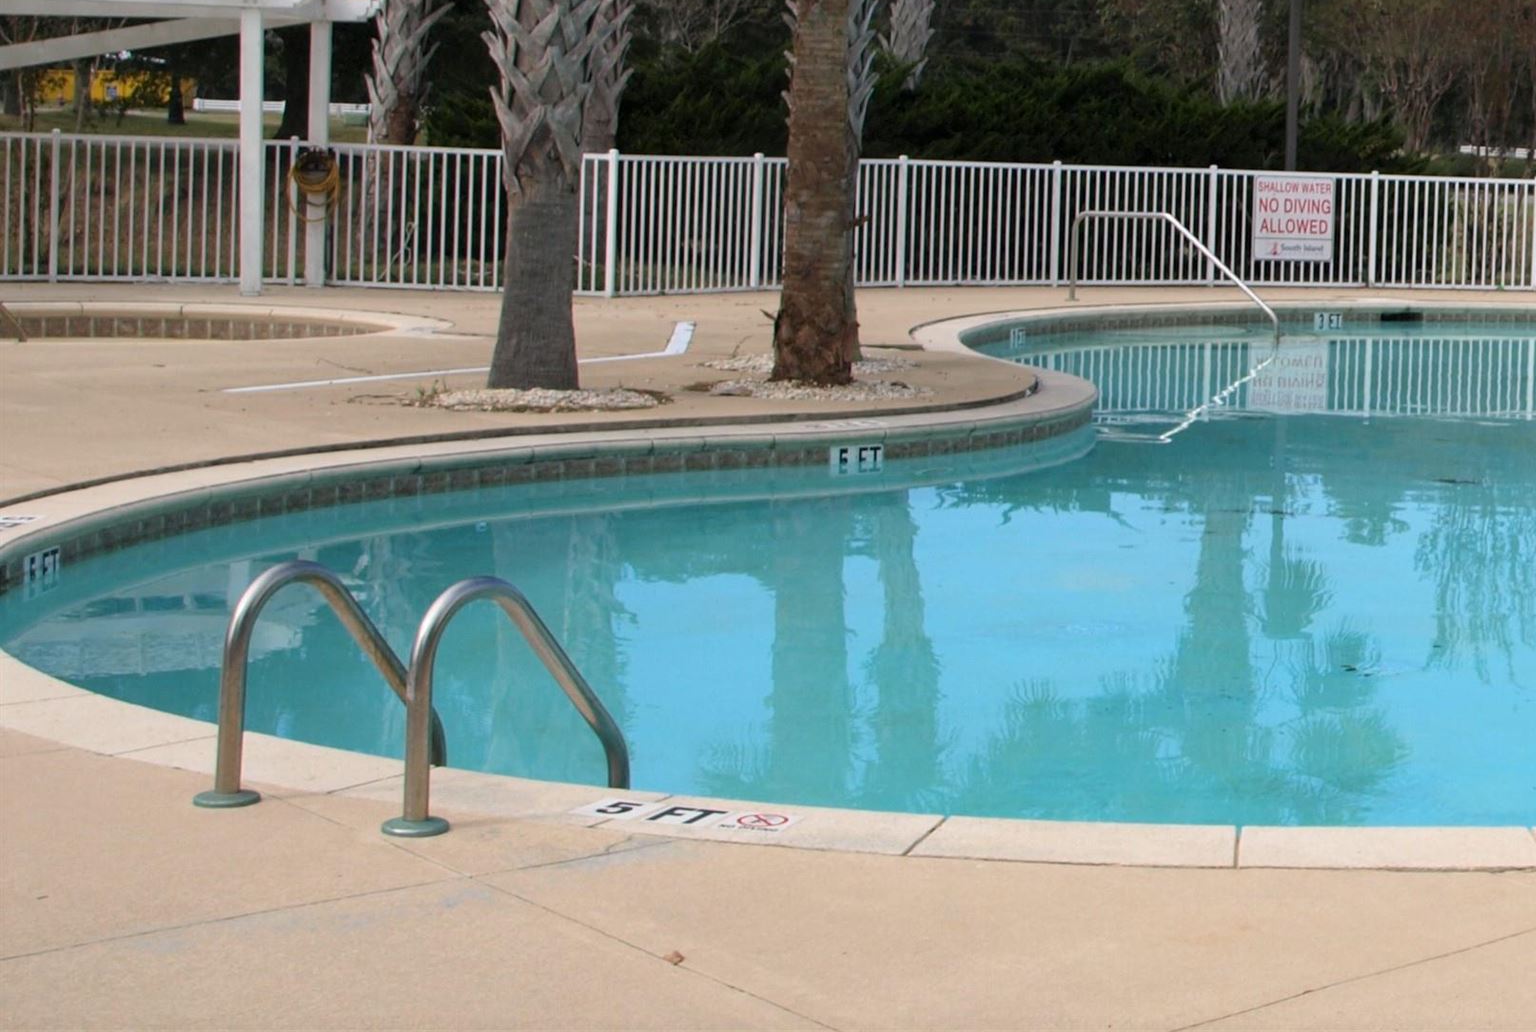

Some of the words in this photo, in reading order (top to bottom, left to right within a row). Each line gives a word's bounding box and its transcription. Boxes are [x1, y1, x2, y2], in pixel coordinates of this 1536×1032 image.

[1258, 181, 1299, 193] SHALLOW
[1301, 182, 1331, 194] WATER
[1259, 197, 1279, 213] NO
[1284, 198, 1331, 214] DIVING
[1260, 218, 1328, 234] ALLOWED
[859, 446, 881, 471] FT
[595, 801, 644, 816] 5
[645, 806, 729, 825] FT
